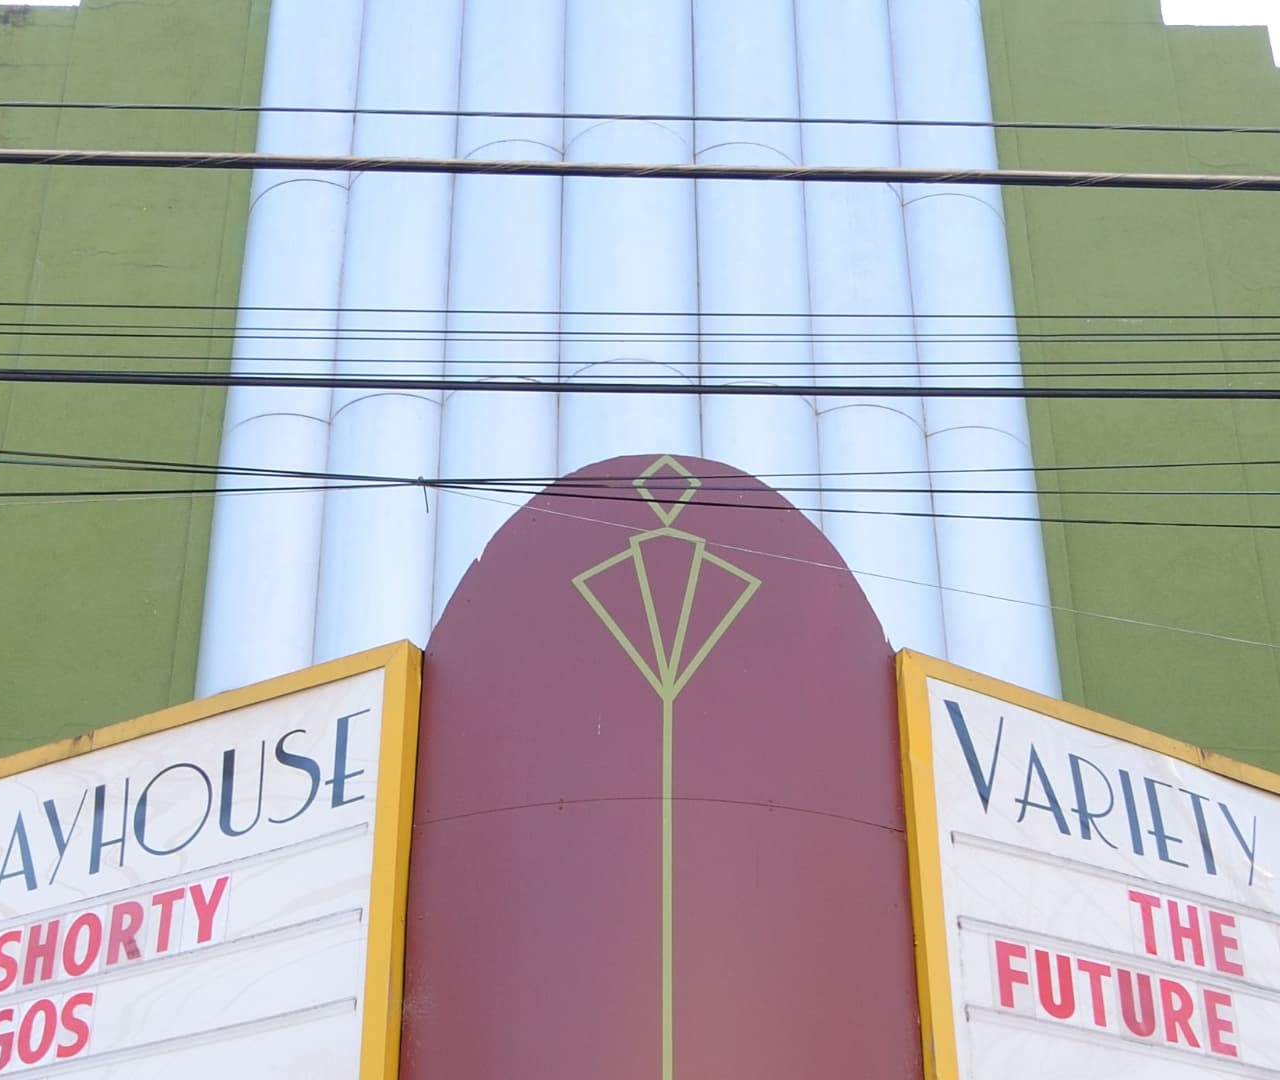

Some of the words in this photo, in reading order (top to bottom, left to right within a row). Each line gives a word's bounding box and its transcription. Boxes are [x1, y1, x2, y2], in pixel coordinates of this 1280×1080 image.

[944, 700, 1257, 886] VARIETY
[1130, 890, 1244, 976] THE
[995, 940, 1238, 1058] FUTURE
